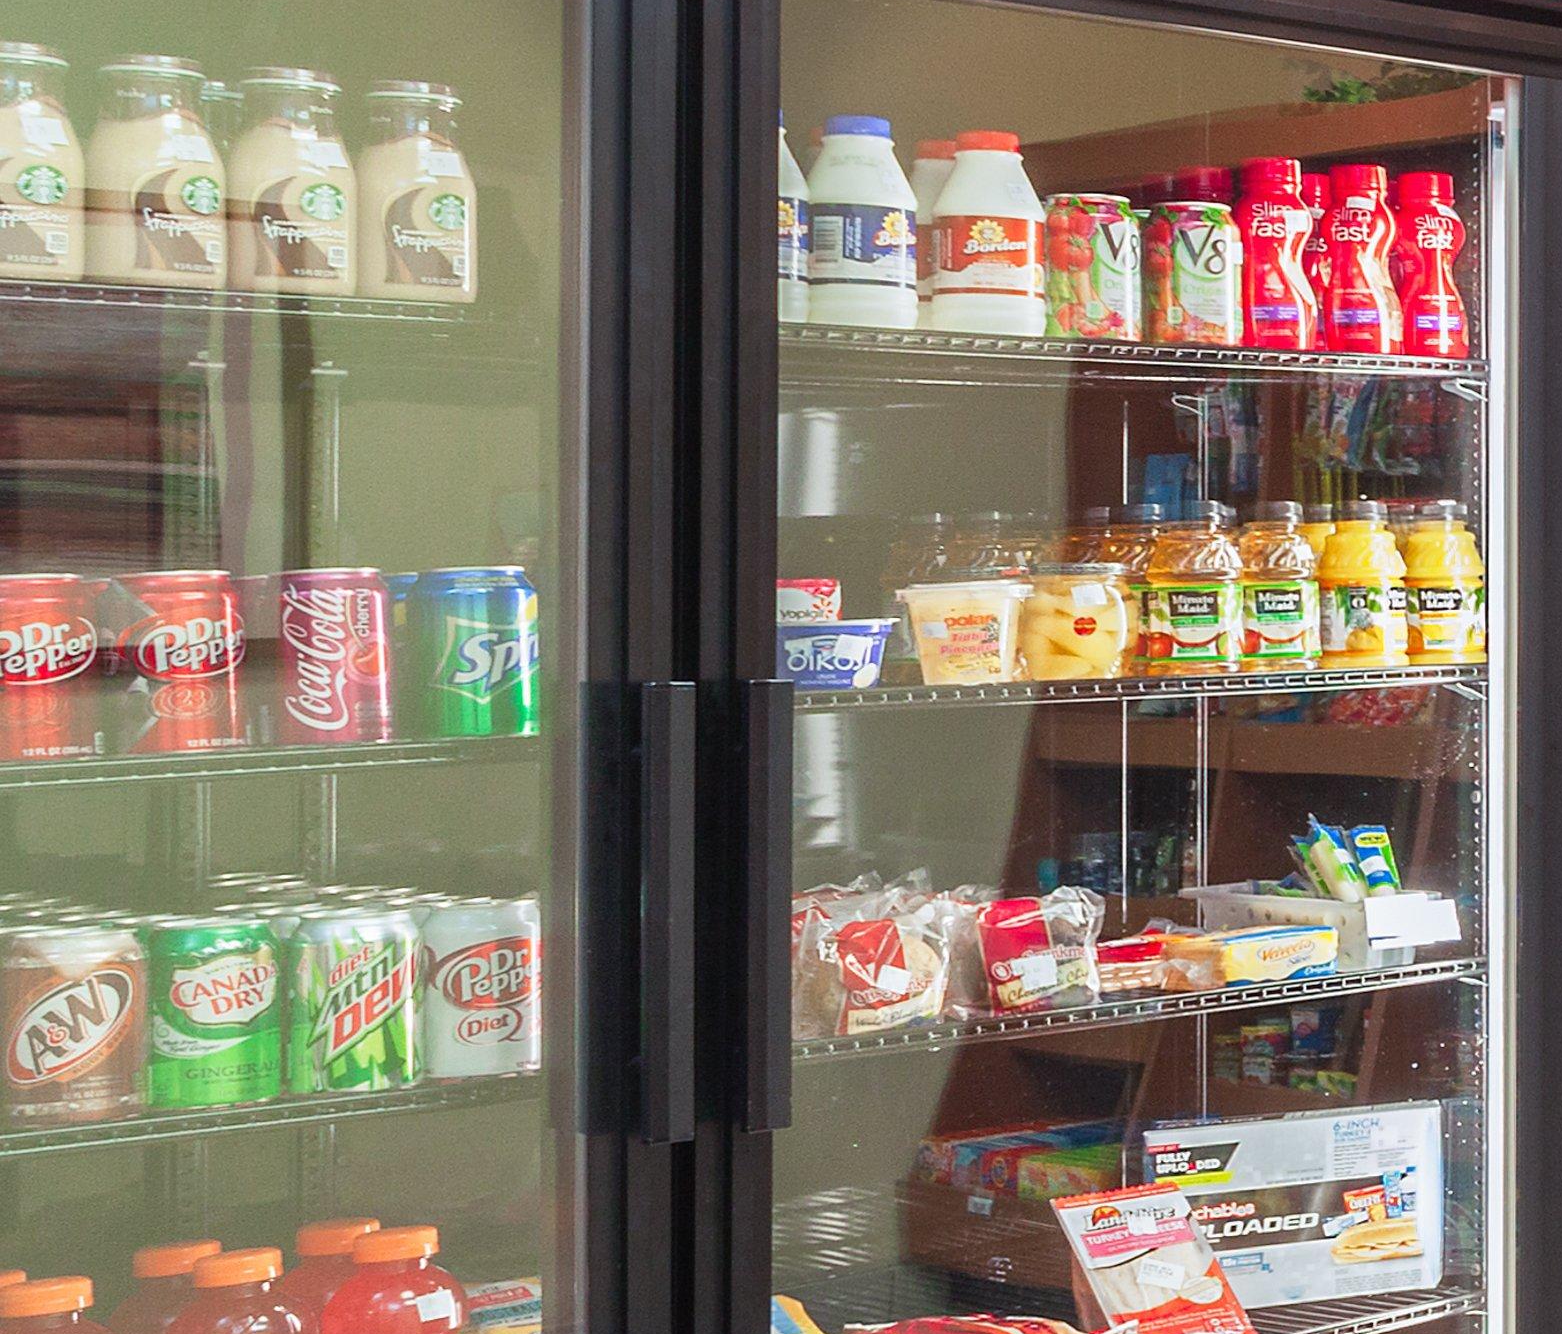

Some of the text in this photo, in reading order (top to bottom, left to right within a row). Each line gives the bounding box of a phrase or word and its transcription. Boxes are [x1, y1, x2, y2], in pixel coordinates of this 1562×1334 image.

[1252, 202, 1294, 218] slim
[1333, 207, 1372, 222] slim
[1414, 215, 1453, 230] slim
[1251, 217, 1287, 239] fas
[1331, 223, 1373, 242] fast
[1179, 225, 1227, 275] V8
[1257, 592, 1300, 604] Minute
[1264, 601, 1296, 612] Maid
[356, 588, 371, 637] cherry
[21, 623, 70, 650] Dr
[195, 617, 230, 642] Dr
[283, 583, 351, 732] Coca-Cola
[452, 631, 539, 691] Spri
[328, 946, 373, 986] diet
[211, 986, 266, 1018] DRY
[29, 972, 116, 1077] A&W
[466, 1013, 510, 1040] Diet
[1200, 1213, 1319, 1244] LOADED
